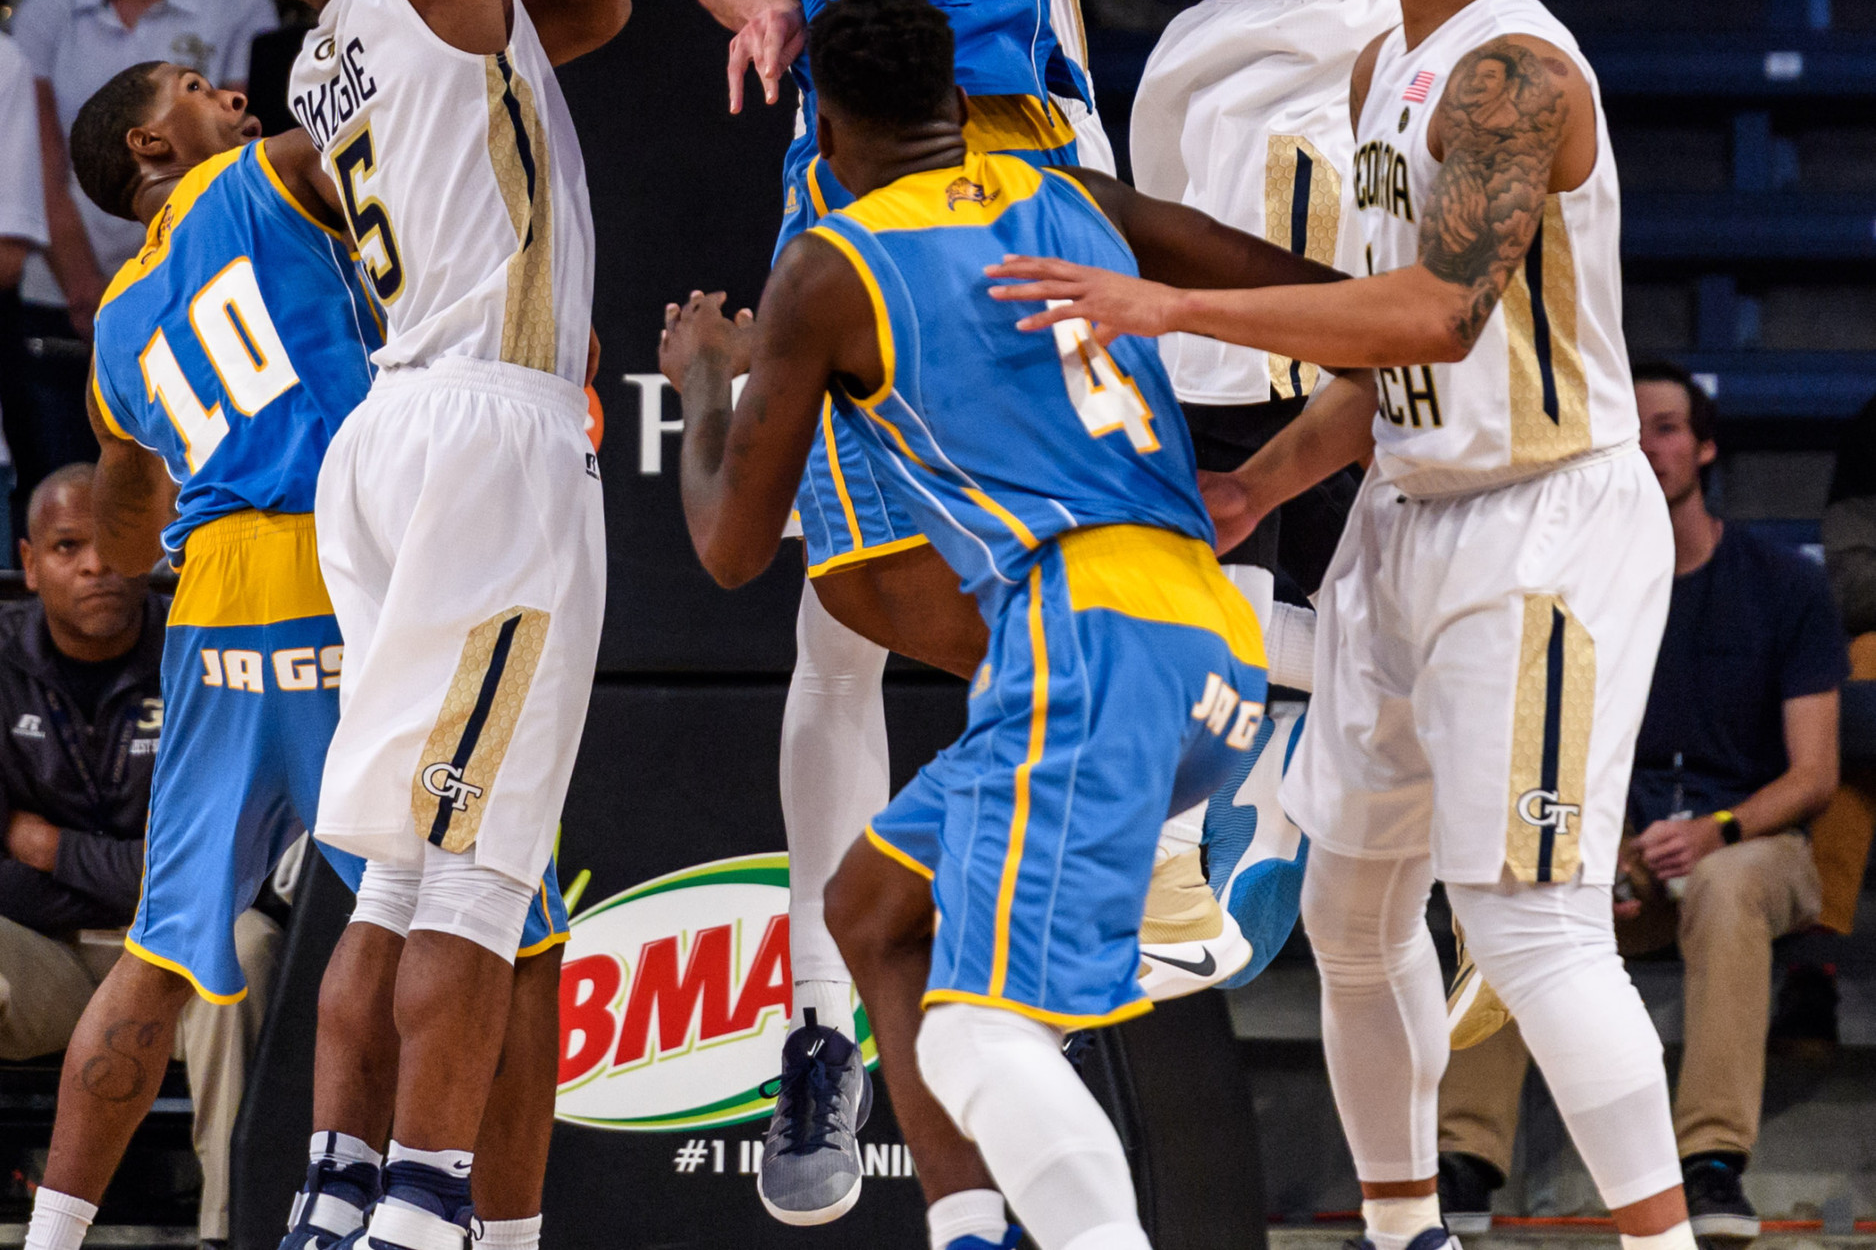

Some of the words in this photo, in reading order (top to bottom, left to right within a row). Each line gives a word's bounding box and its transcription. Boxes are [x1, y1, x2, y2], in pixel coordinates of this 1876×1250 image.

[330, 120, 407, 307] 5
[138, 255, 301, 476] 10
[1046, 299, 1162, 454] 4
[421, 762, 484, 812] GT
[1516, 788, 1581, 835] GT
[673, 1139, 725, 1174] #1
